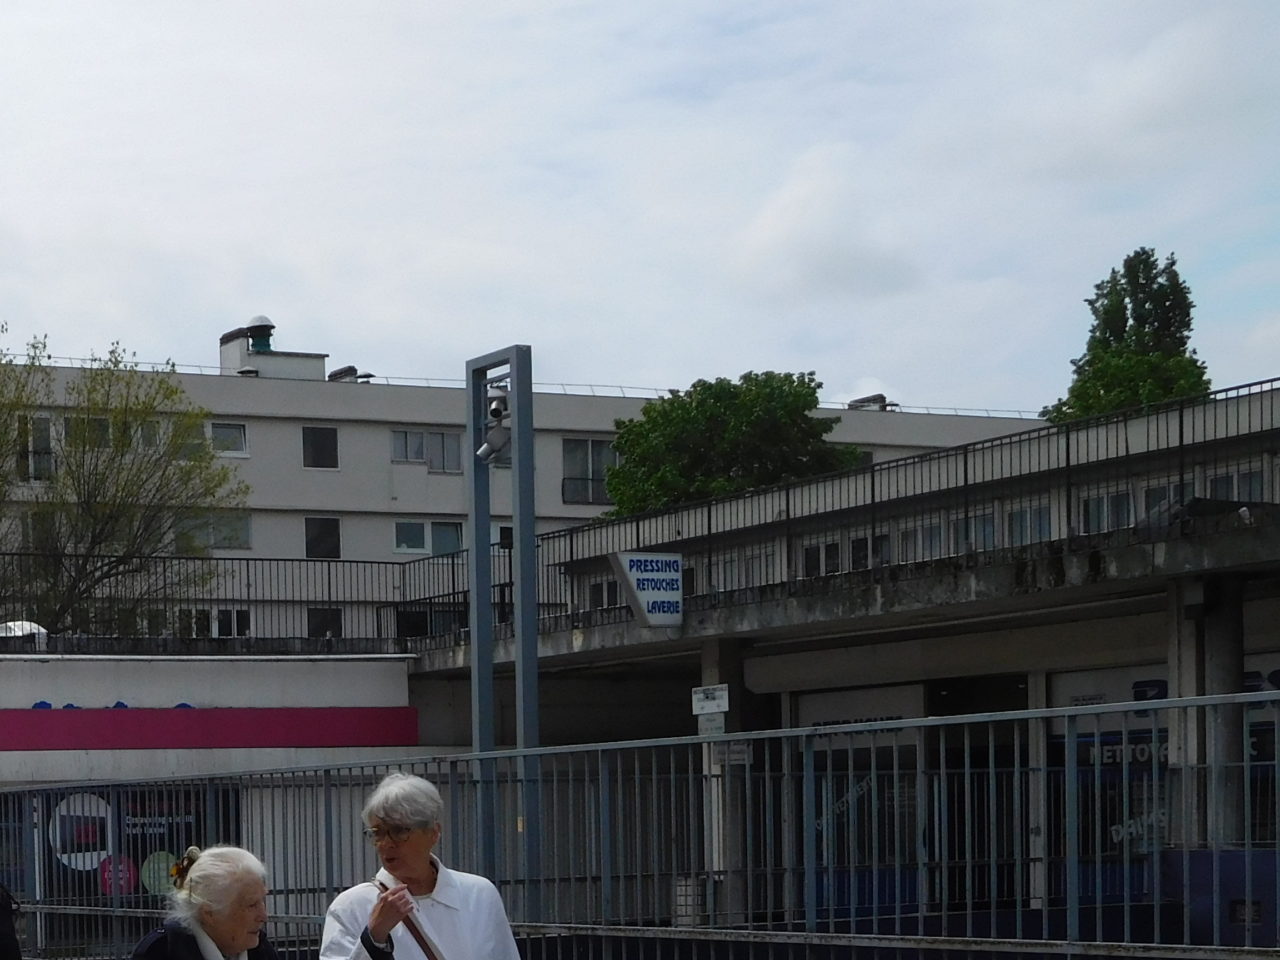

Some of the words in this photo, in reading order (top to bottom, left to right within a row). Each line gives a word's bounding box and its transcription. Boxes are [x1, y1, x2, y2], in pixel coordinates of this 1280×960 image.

[629, 559, 679, 573] PRESSING
[636, 578, 679, 592] RETOUCHES
[647, 600, 680, 614] LAVERIE
